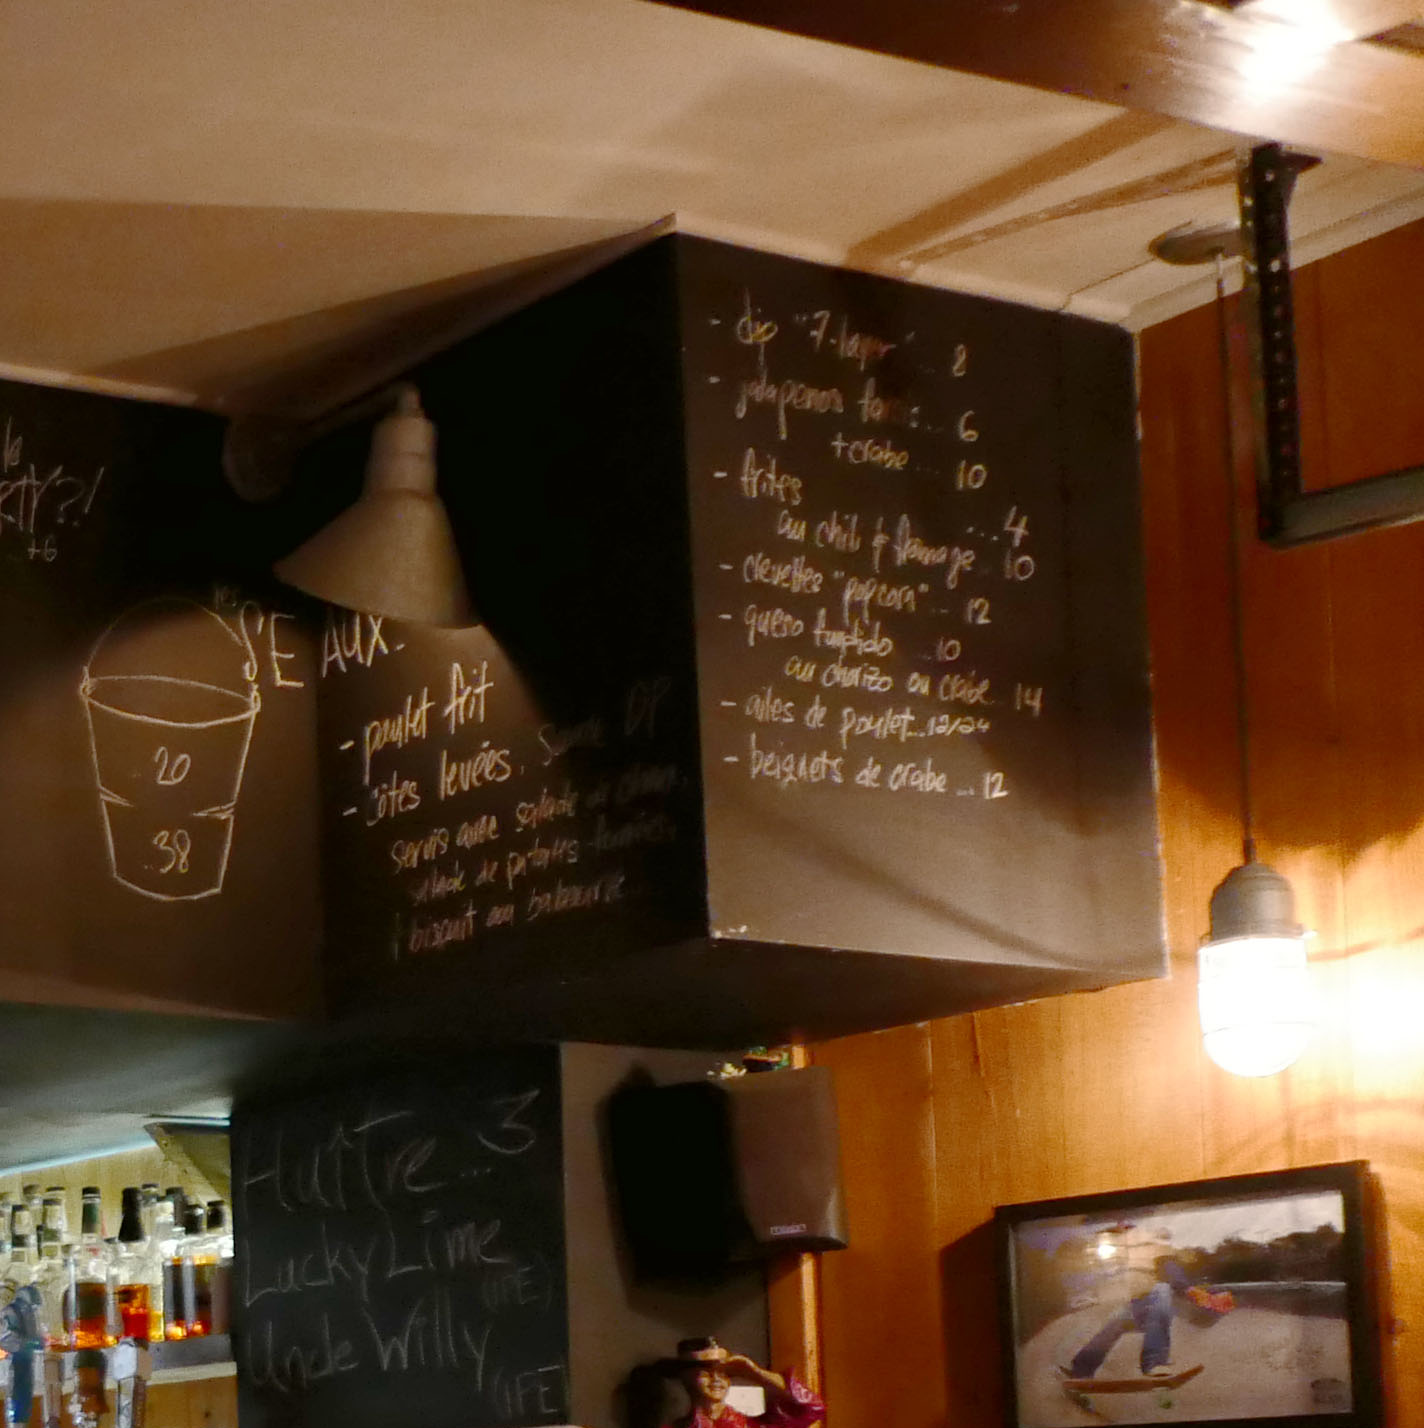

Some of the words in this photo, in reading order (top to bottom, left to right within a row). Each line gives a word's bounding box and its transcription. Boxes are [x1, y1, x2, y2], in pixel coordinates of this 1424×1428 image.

[956, 459, 988, 490] 10
[1003, 505, 1029, 548] 4
[444, 660, 494, 735] frit
[1013, 680, 1046, 720] 14
[150, 744, 194, 788] 20
[854, 756, 882, 788] de
[887, 759, 949, 795] crabe
[981, 770, 1010, 801] 12
[476, 1086, 543, 1156] 3
